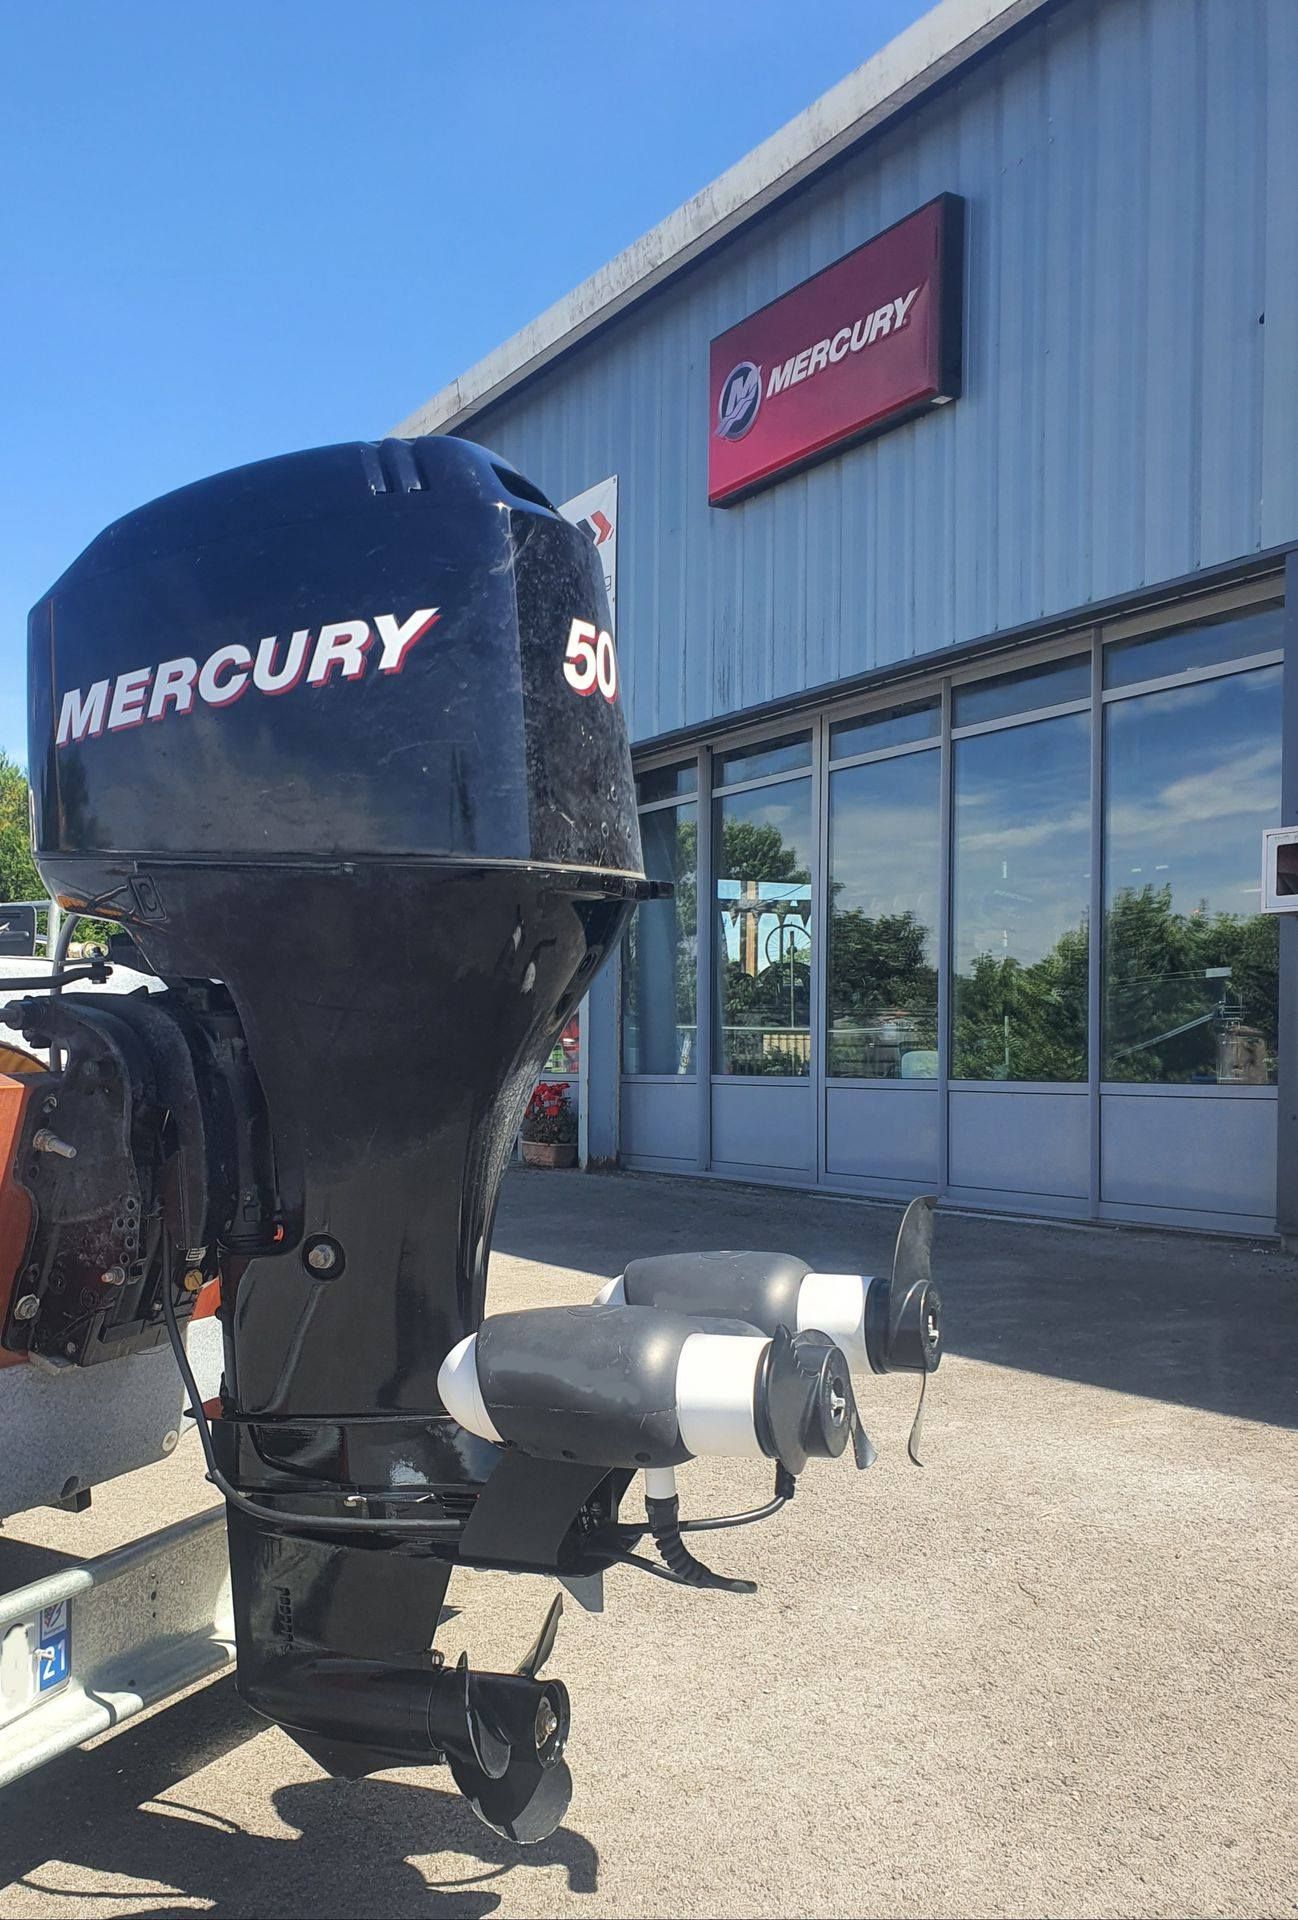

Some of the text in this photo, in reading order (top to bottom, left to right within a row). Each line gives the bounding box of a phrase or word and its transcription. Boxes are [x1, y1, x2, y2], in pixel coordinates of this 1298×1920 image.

[766, 288, 919, 399] MERCURY
[55, 607, 440, 747] MERCURY
[563, 618, 617, 703] 50
[43, 1639, 65, 1680] 21
